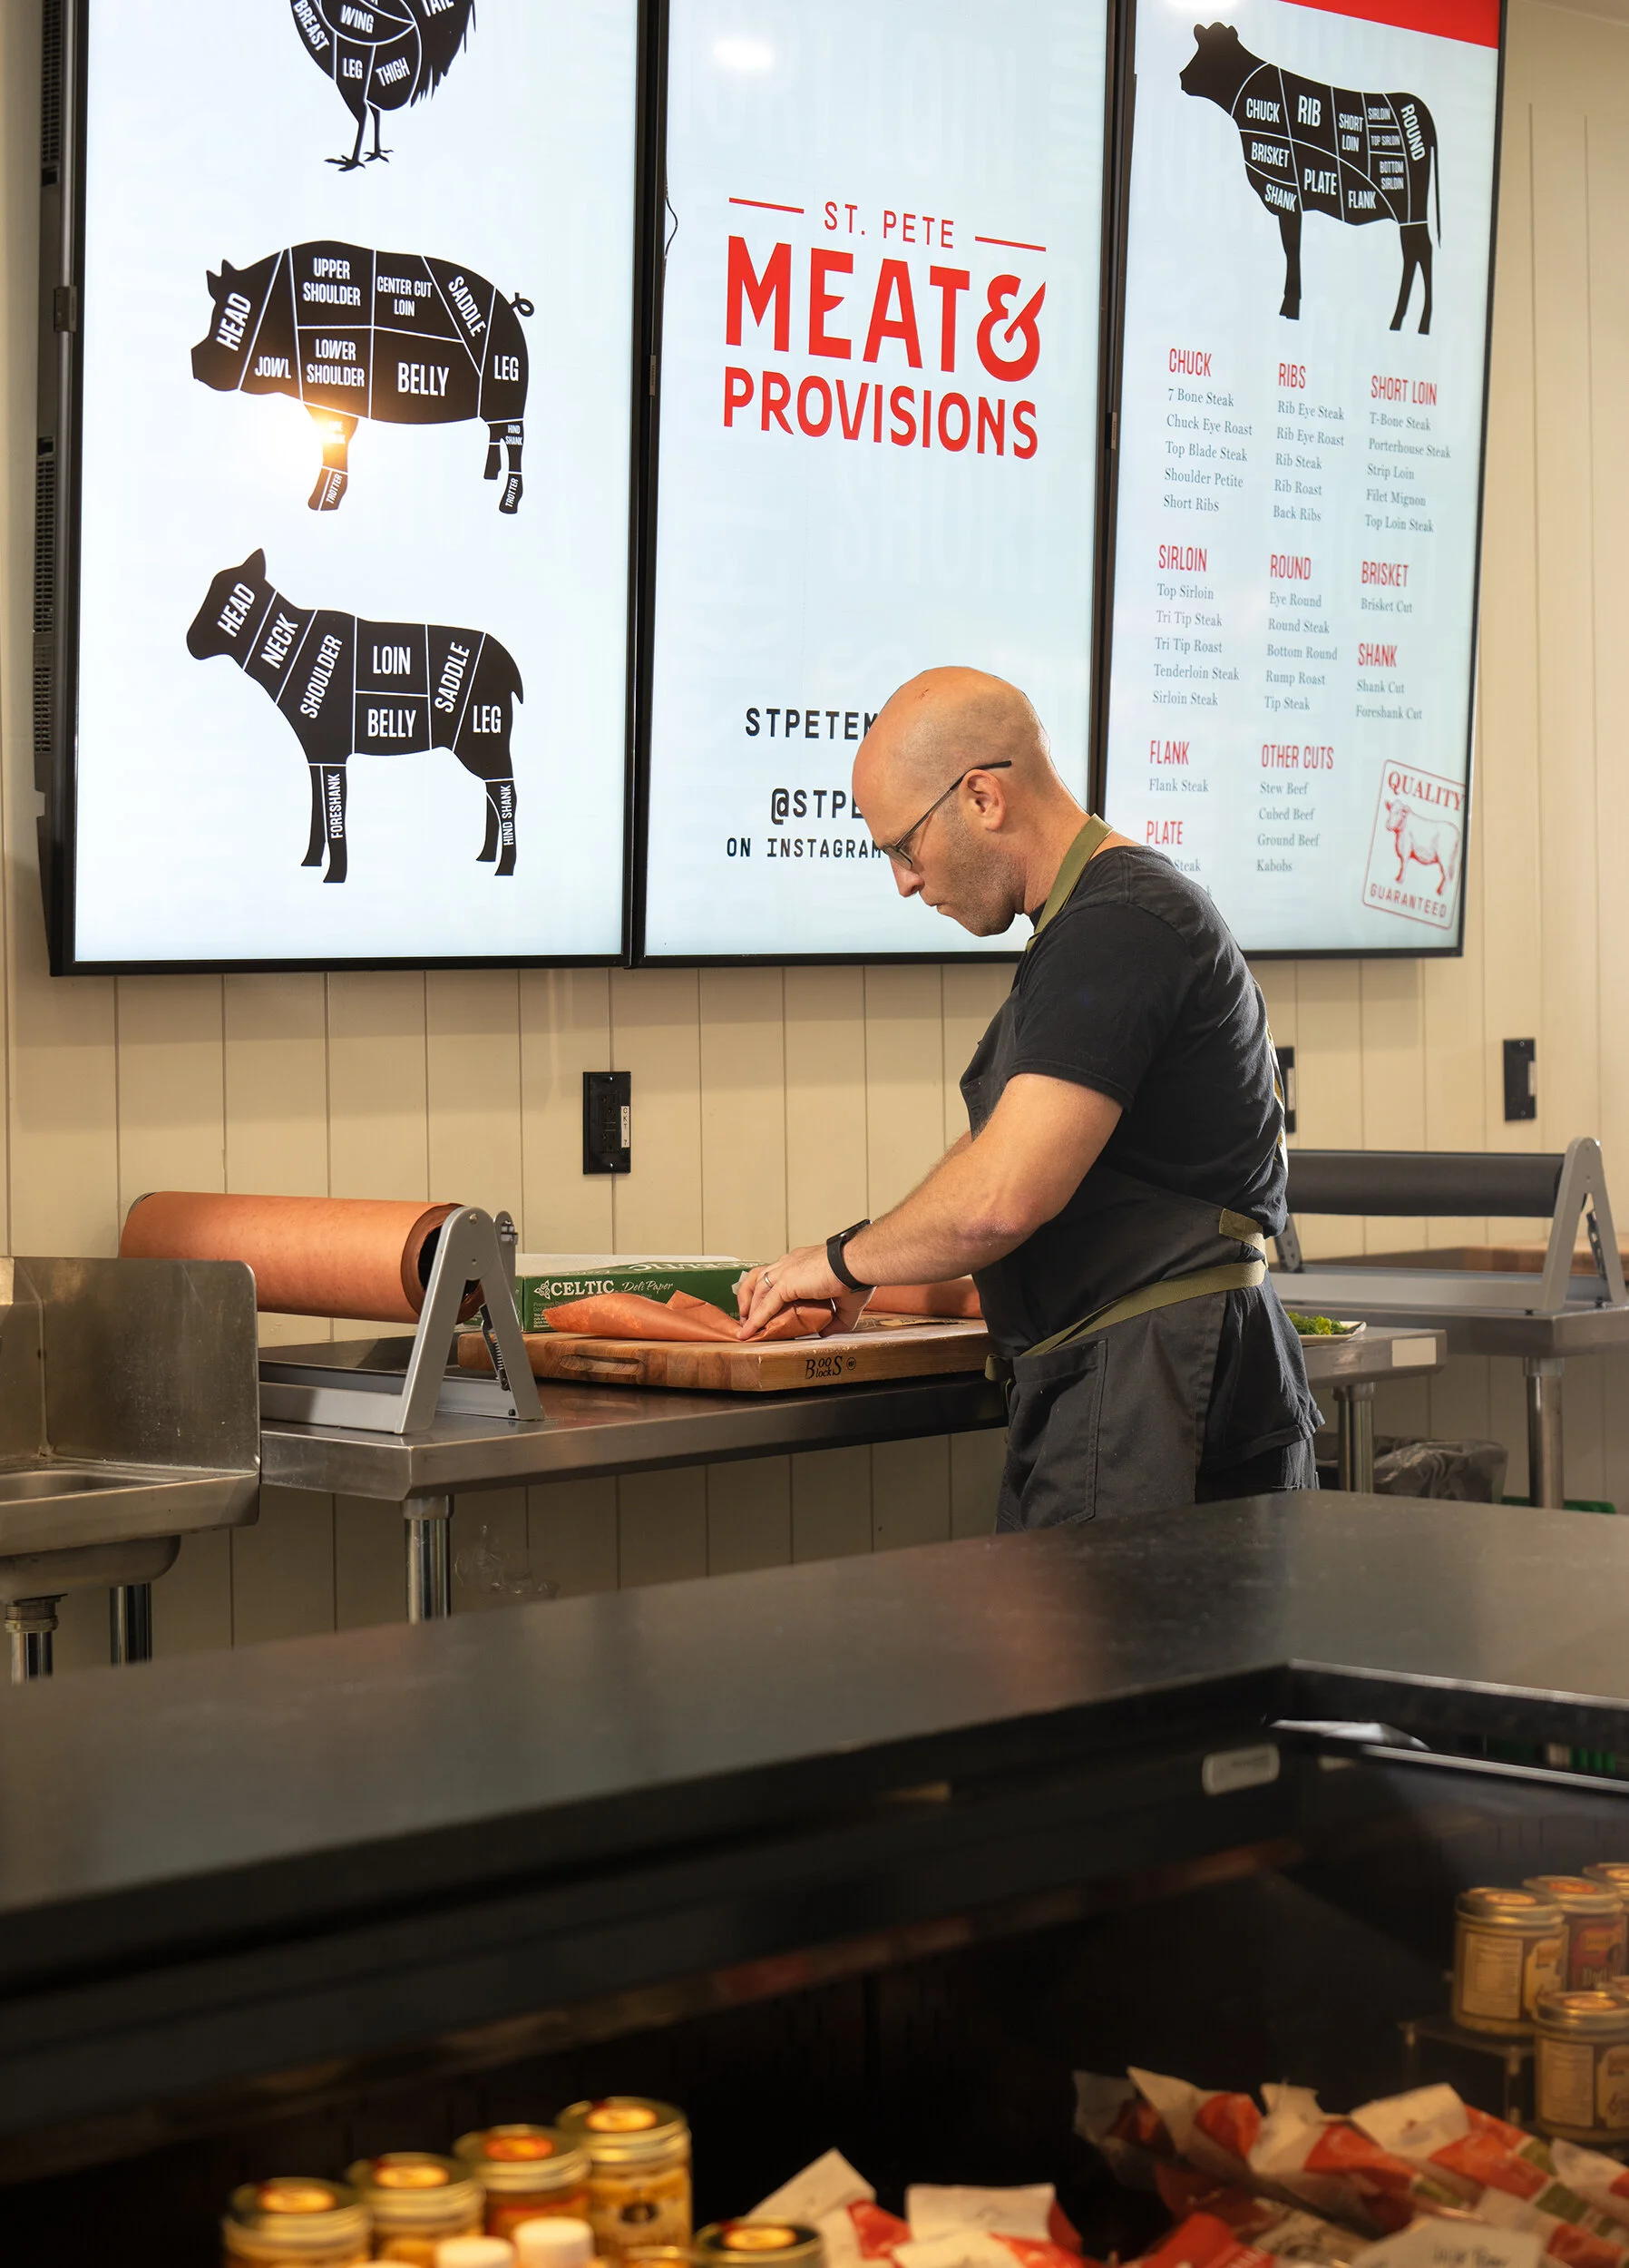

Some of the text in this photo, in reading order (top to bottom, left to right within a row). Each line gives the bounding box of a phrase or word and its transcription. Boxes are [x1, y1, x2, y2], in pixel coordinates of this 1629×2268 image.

[293, 0, 330, 51] BREAST
[340, 5, 374, 34] WING
[343, 58, 363, 79] LEG
[376, 57, 410, 86] THIGH
[1245, 98, 1280, 123] CHUCK
[1298, 94, 1322, 127] RIB
[1368, 108, 1390, 120] SIRLOIN
[1339, 112, 1363, 132] SHORT
[1400, 103, 1425, 161] ROUND
[1341, 133, 1359, 152] LOIN
[1371, 135, 1400, 146] TOP SIRLOIN
[1252, 142, 1290, 168] BRISKET
[1380, 161, 1404, 173] BOTTOM
[1304, 168, 1337, 196] PLATE
[1380, 178, 1404, 190] SIRLOIN
[1264, 183, 1297, 212] SHANK
[1348, 190, 1376, 210] FLANK
[824, 201, 954, 249] ST. PETE
[314, 257, 350, 280] UPPER
[303, 281, 361, 308] SHOULDER
[376, 276, 433, 298] CENTER CUT
[394, 298, 415, 318] LOIN
[448, 276, 487, 338] SADDLE
[215, 291, 252, 352] HEAD
[315, 338, 356, 362] LOWER
[255, 357, 291, 380] JOWL
[493, 356, 519, 382] LEG
[1168, 348, 1212, 376] CHUCK
[306, 362, 365, 387] SHOULDER
[397, 362, 449, 397] BELLY
[1278, 362, 1306, 388] RIBS
[1168, 387, 1234, 406] 7 Bone Steak
[1371, 376, 1437, 406] SHORT LOIN
[723, 366, 1038, 460] PROVISIONS
[1278, 400, 1344, 420] Rib Eye Steak
[508, 425, 521, 434] HIND
[1166, 414, 1253, 435] Chuck Eye Roast
[1370, 412, 1431, 431] T-Bone Steak
[505, 435, 522, 445] SHANK
[1277, 427, 1344, 445] Rib Eye Roast
[1166, 441, 1248, 462] Top Blade Steak
[1369, 438, 1451, 458] Porterhouse Steak
[1276, 453, 1322, 469] Rib Steak
[1165, 468, 1244, 487] Shoulder Petite
[1368, 464, 1414, 480] Strip Loin
[327, 474, 343, 503] TROTTER
[505, 478, 518, 507] TROTTER
[1274, 479, 1322, 496] Rib Roast
[1367, 489, 1426, 507] Filet Mignon
[1163, 494, 1219, 513] Short Ribs
[1273, 505, 1322, 522] Back Ribs
[1365, 514, 1434, 533] Top Loin Steak
[1158, 545, 1207, 572] SIRLOIN
[1270, 554, 1312, 581] ROUND
[1361, 561, 1409, 587] BRISKET
[1157, 583, 1214, 600] Top Sirloin
[1270, 591, 1322, 608] Eye Round
[216, 582, 255, 638] HEAD
[1361, 598, 1412, 613] Brisket Cut
[1156, 610, 1222, 628] Tri Tip Steak
[1269, 619, 1330, 633] Round Steak
[260, 611, 298, 669] NECK
[1155, 637, 1222, 654] Tri Tip Roast
[373, 645, 411, 675] LOIN
[1267, 645, 1338, 661] Bottom Round
[1358, 643, 1397, 668] SHANK
[299, 633, 343, 720] SHOULDER
[434, 640, 472, 713] SADDLE
[1154, 664, 1239, 680] Tenderloin Steak
[1266, 670, 1325, 686] Rump Roast
[1357, 679, 1404, 694] Shank Cut
[1153, 690, 1218, 706] Sirloin Steak
[1264, 697, 1310, 711] Tip Steak
[473, 704, 502, 734] LEG
[1356, 705, 1422, 719] Foreshank Cut
[367, 708, 416, 738] BELLY
[1149, 740, 1189, 766] FLANK
[1262, 744, 1333, 769] OTHER CUTS
[1149, 778, 1209, 792] Flank Steak
[1260, 781, 1309, 795] Stew Beef
[1387, 771, 1465, 812] QUALITY
[327, 773, 342, 840] FORESHANK
[502, 784, 514, 846] HIND SHANK
[1259, 807, 1314, 821] Cubed Beef
[1146, 821, 1183, 845] PLATE
[1258, 834, 1321, 846] Ground Beef
[727, 837, 882, 858] ON INSTAGRAM
[1173, 859, 1201, 872] Steak
[1257, 859, 1292, 872] Kabobs
[1370, 885, 1447, 918] GUARANTEED
[551, 1280, 673, 1295] CELTIC Deli Paper
